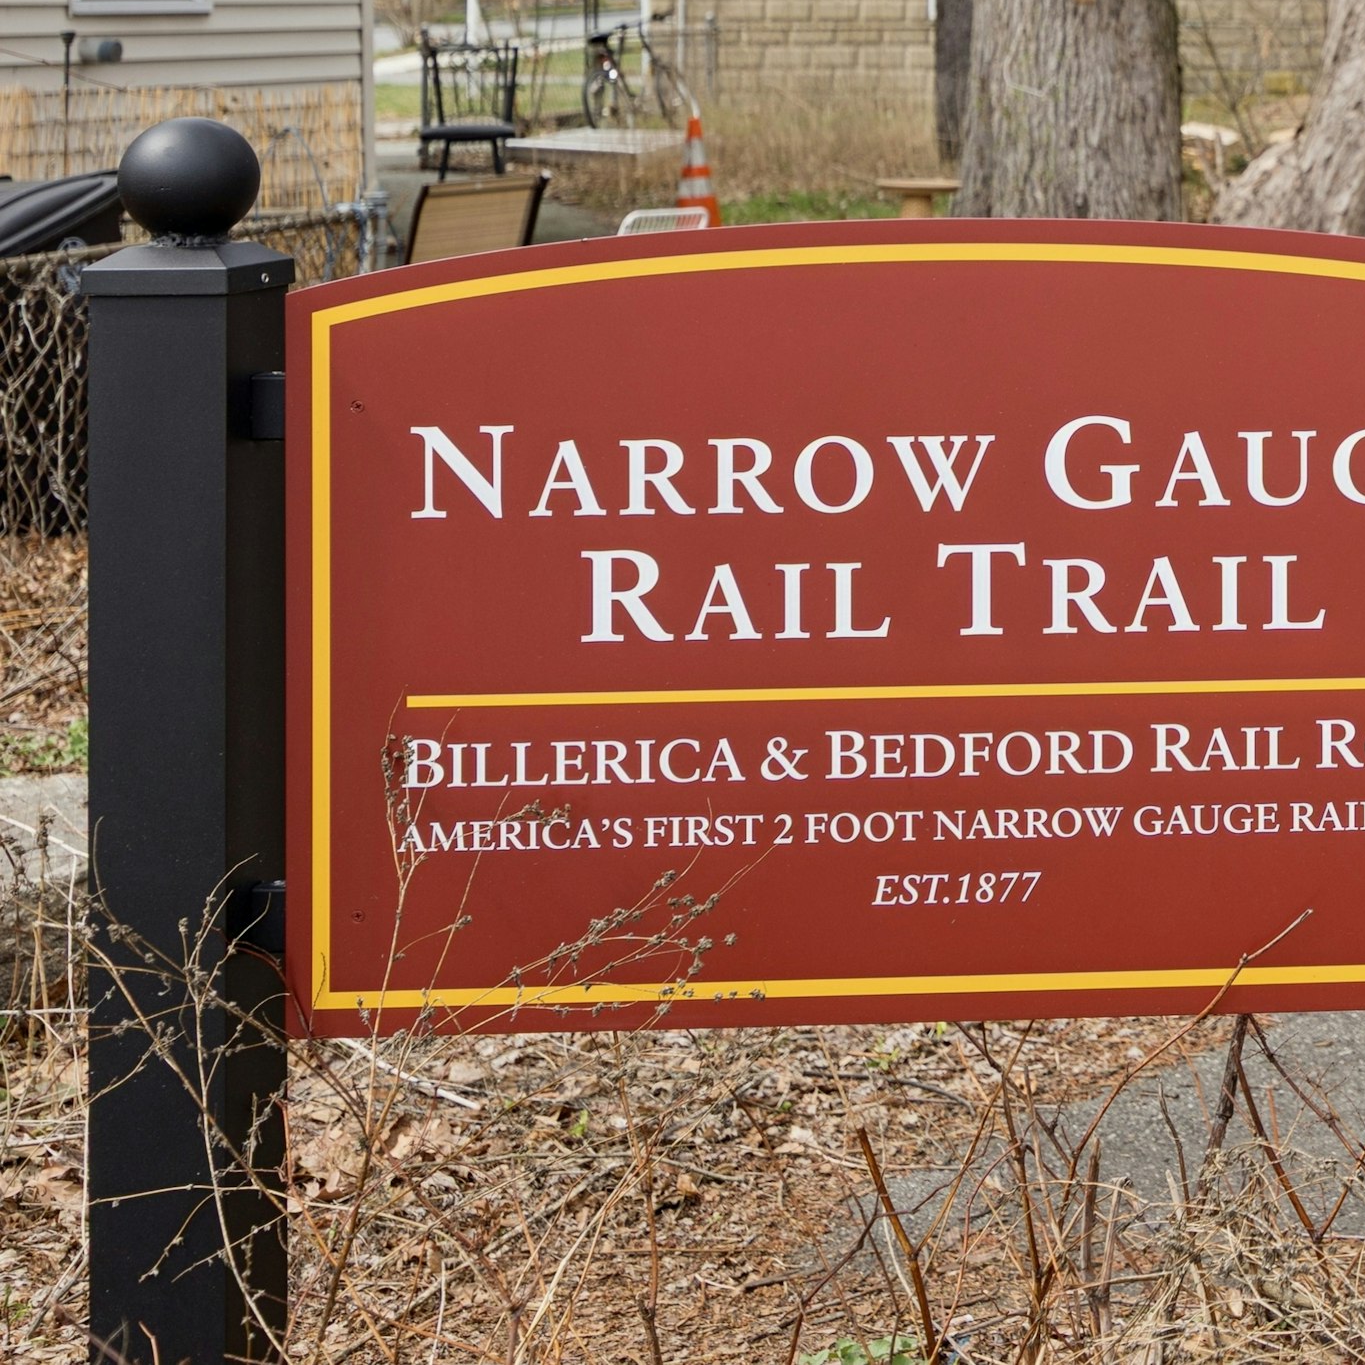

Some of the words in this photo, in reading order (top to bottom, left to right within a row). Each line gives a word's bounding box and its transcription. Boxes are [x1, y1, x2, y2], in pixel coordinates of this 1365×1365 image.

[410, 425, 996, 519] NARROW
[580, 549, 891, 643] RAIL
[937, 541, 1327, 636] TRAIL
[402, 737, 746, 788] BILLERICA
[760, 736, 809, 781] &
[825, 730, 1134, 779] BEDFORD
[1150, 723, 1301, 772] RAIL
[397, 817, 633, 853] AMERICA'S
[643, 814, 764, 847] FIRST
[773, 813, 793, 844] 2
[804, 810, 924, 844] FOOT
[933, 806, 1124, 841] NARROW
[1133, 803, 1281, 836] GAUGE
[871, 871, 1042, 905] EST.1877
